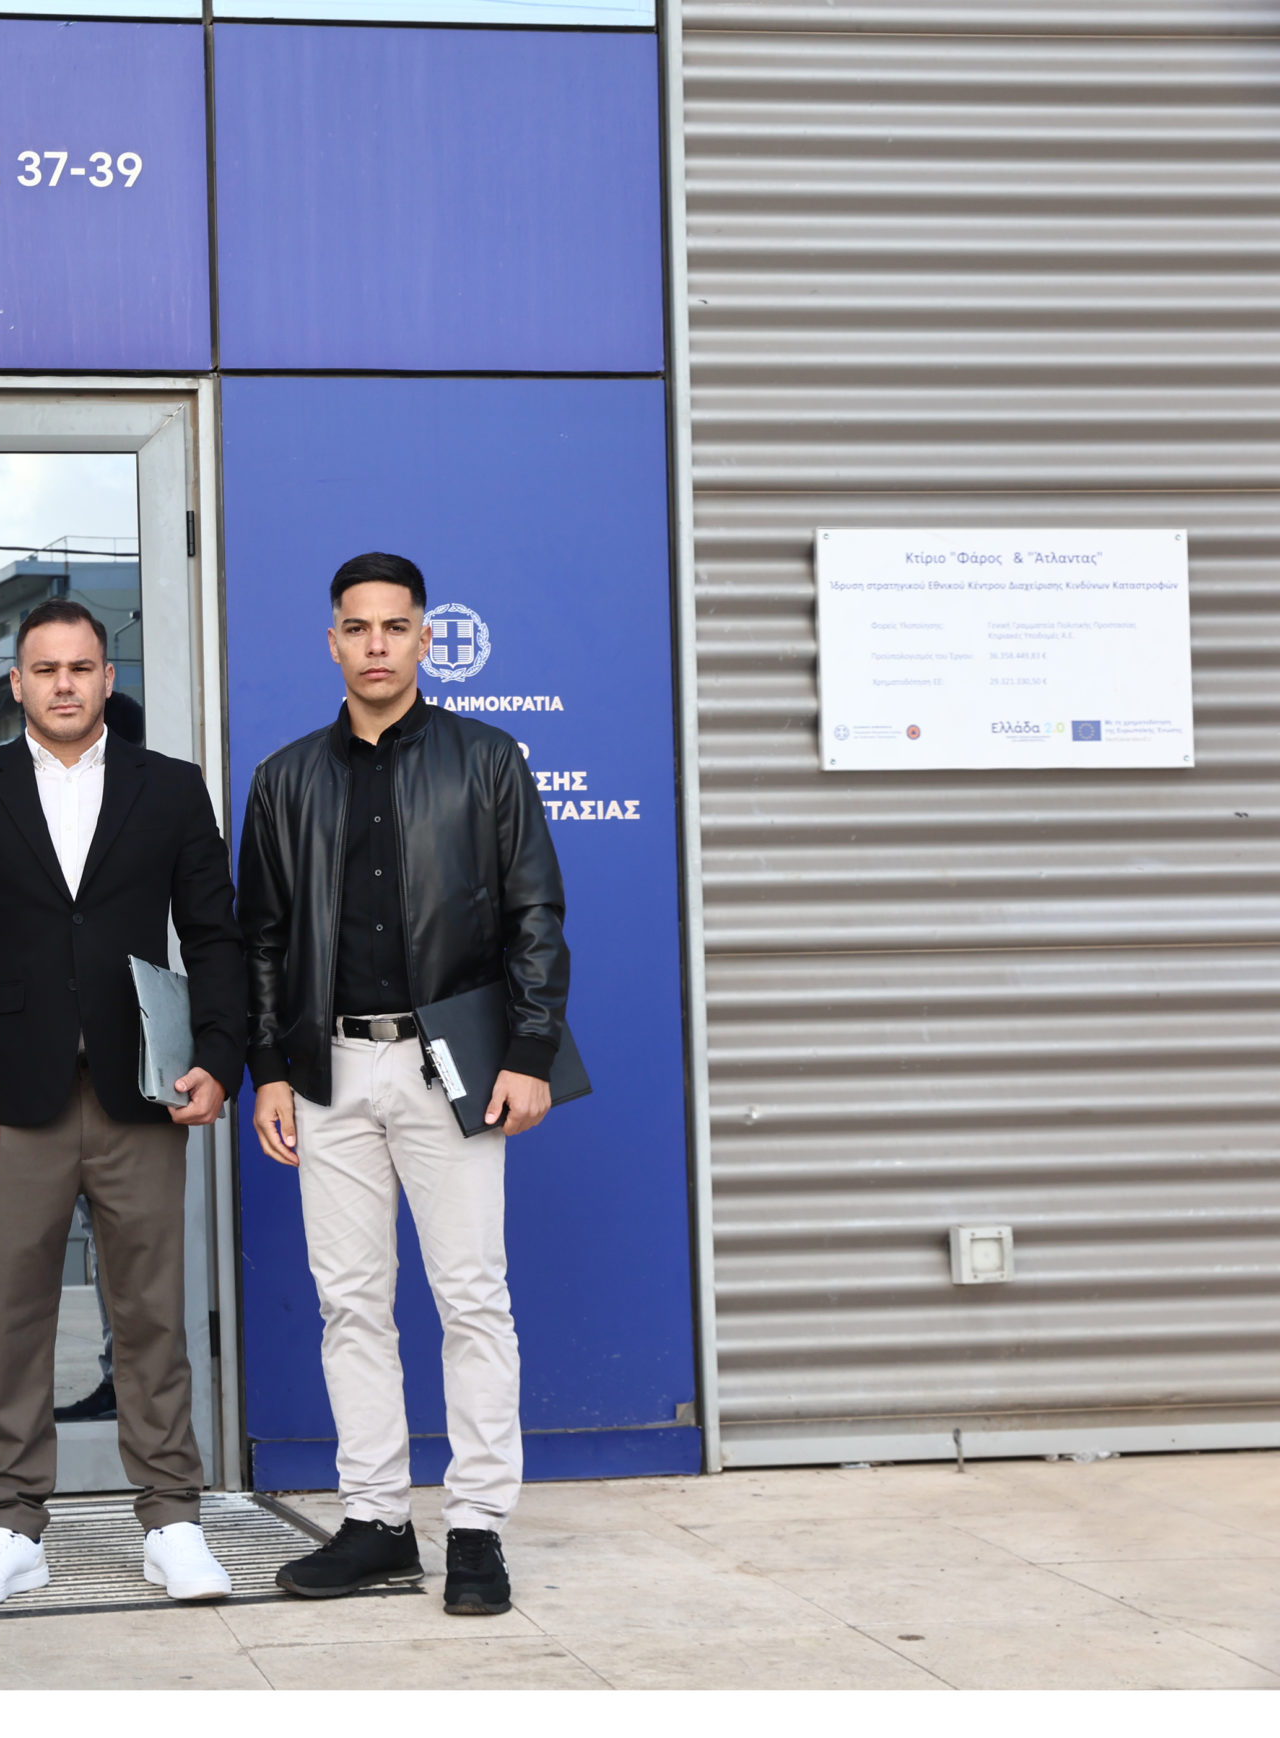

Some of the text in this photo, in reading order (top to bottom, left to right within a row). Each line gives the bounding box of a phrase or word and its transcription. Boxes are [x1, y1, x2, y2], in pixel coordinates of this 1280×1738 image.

[17, 151, 142, 187] 37-39
[905, 551, 946, 566] Κτίριο
[1013, 552, 1023, 564] &
[928, 580, 965, 590] Εθνικού
[968, 580, 1007, 591] Κέντρου
[443, 696, 564, 712] ΔΗΜΟΚΡΑΤΙΑ
[991, 720, 1040, 734] Ελλάδα
